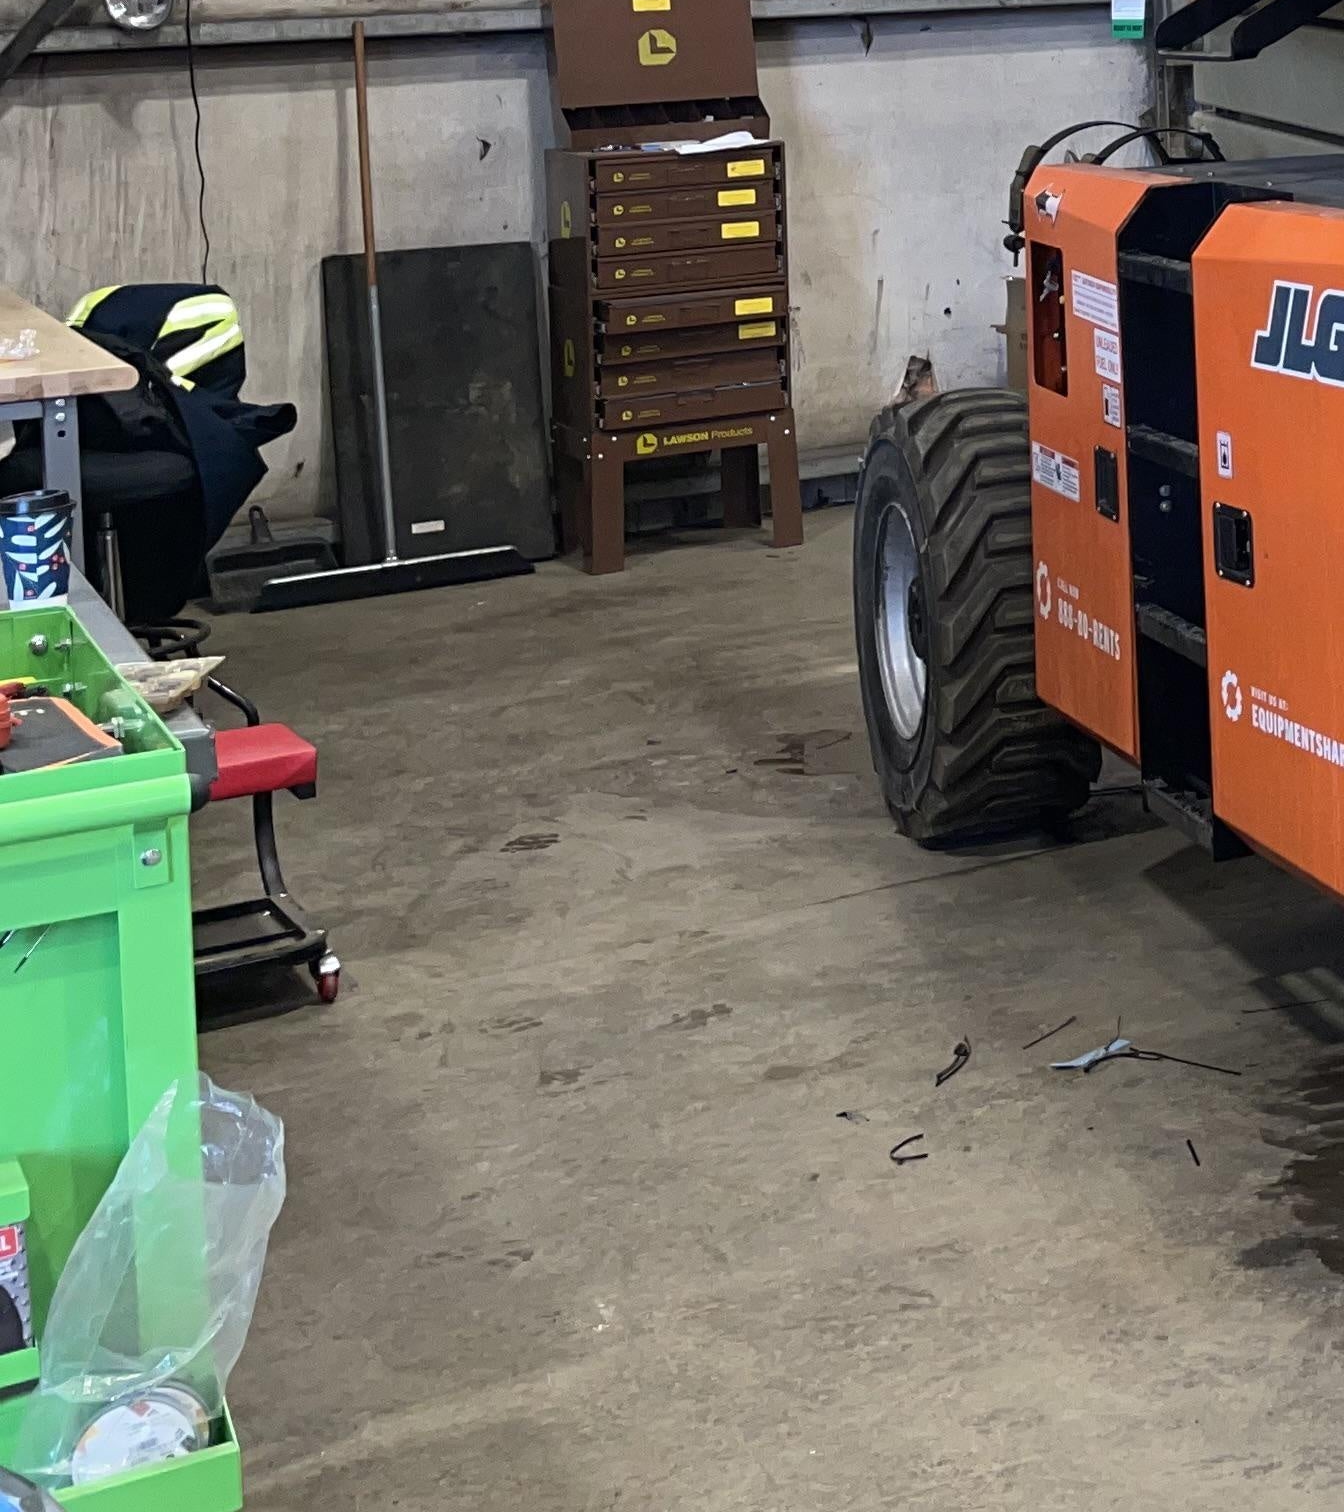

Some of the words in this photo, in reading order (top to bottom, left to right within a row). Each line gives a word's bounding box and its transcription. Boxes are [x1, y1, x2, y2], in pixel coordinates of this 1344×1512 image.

[663, 431, 709, 446] LAWSON
[711, 426, 753, 439] Products
[1251, 686, 1267, 702] VISIT
[1268, 692, 1277, 707] US
